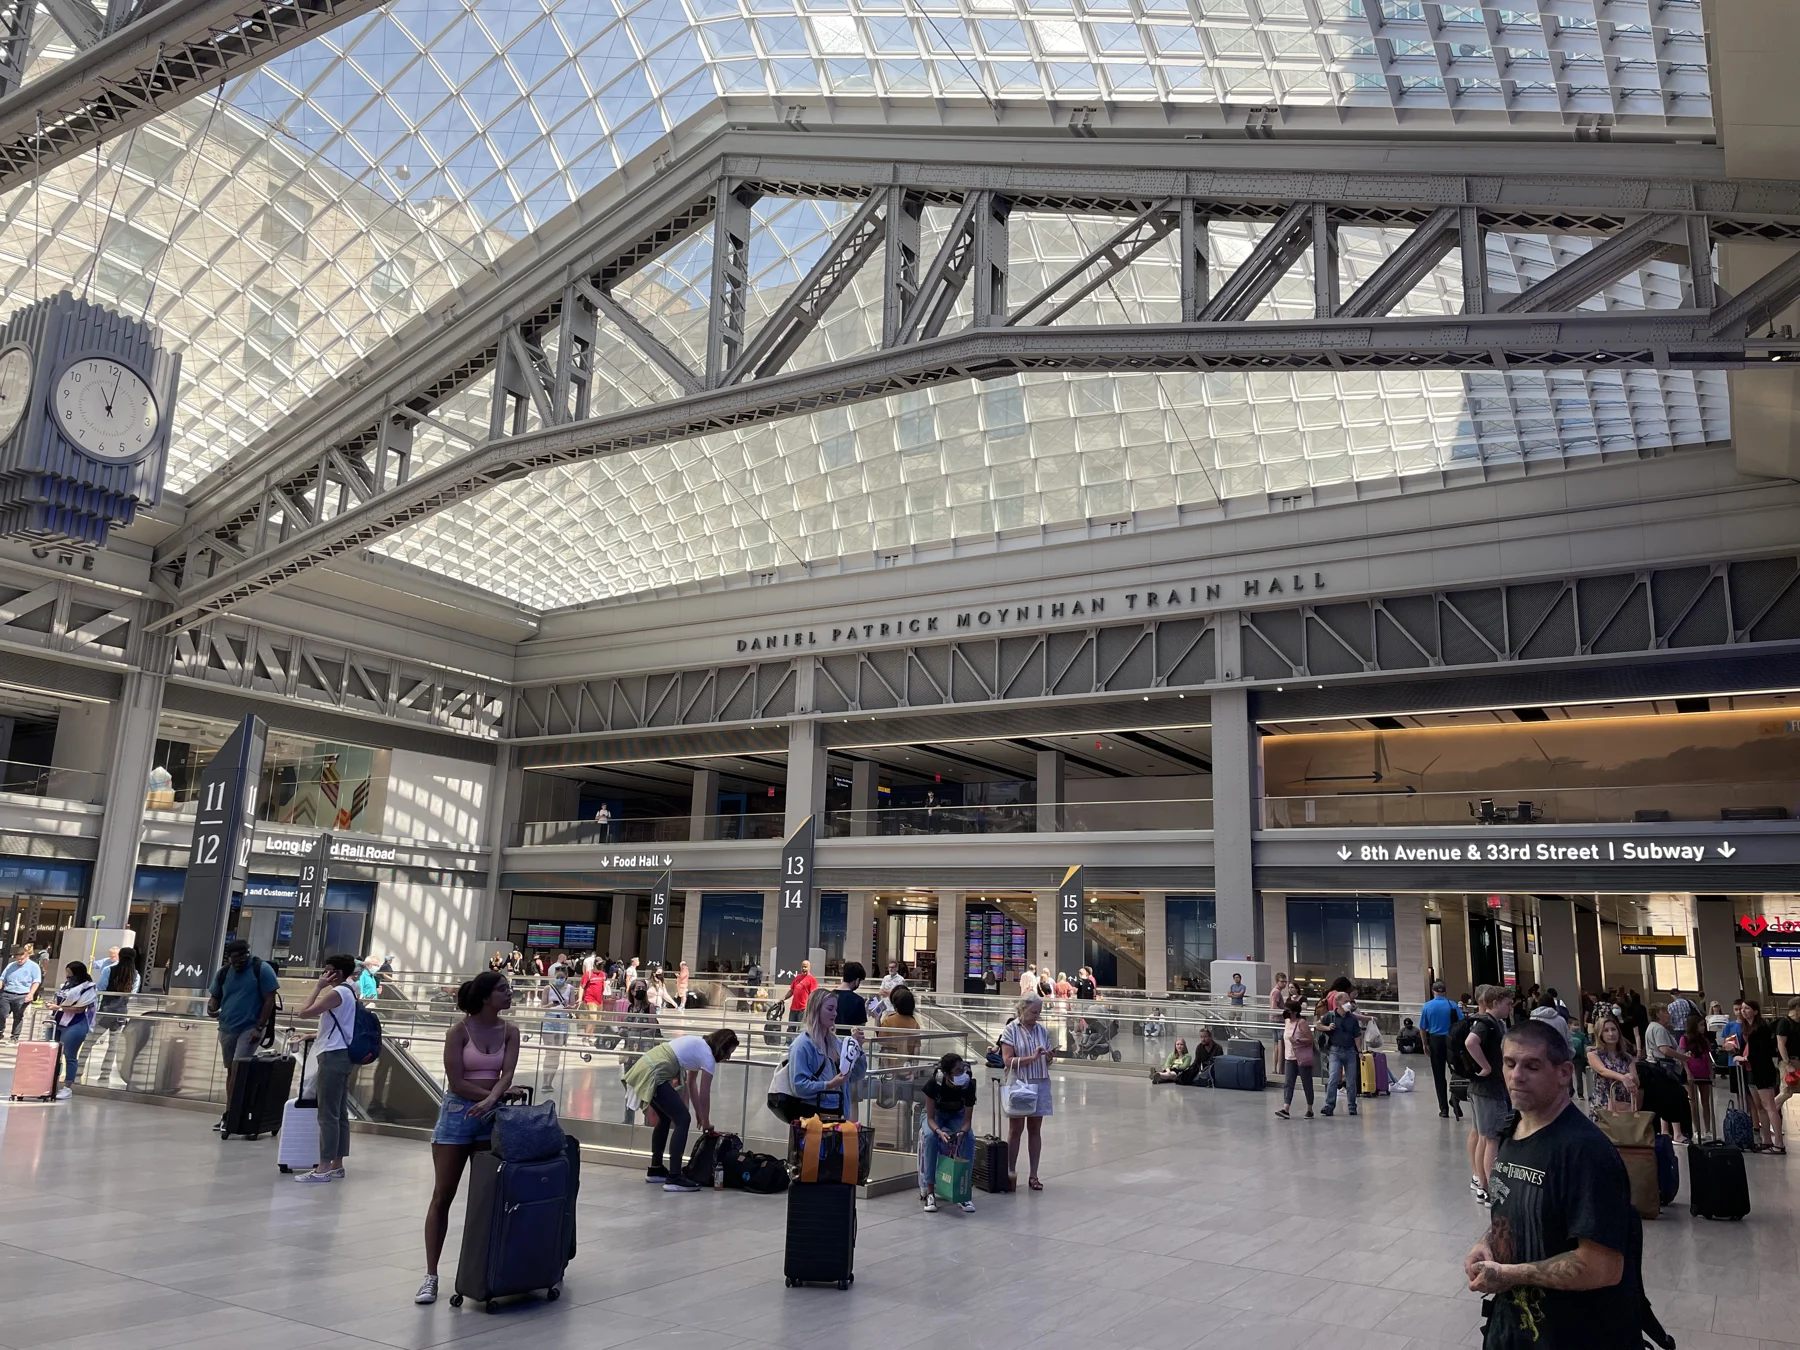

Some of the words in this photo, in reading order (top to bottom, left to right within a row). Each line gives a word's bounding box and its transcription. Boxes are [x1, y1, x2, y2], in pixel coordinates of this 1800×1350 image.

[89, 363, 98, 374] 11
[109, 365, 120, 377] 12
[71, 371, 82, 383] 10
[132, 379, 136, 388] 1
[63, 389, 70, 399] 9
[142, 397, 149, 407] 2
[65, 410, 73, 420] 8
[144, 418, 151, 427] 3
[79, 429, 86, 439] 7
[136, 434, 142, 443] 4
[98, 442, 105, 451] 6
[119, 443, 126, 452] 5
[736, 631, 816, 651] DANIEL
[831, 616, 939, 642] PATRICK
[956, 597, 1105, 628] MOYNIHAN
[1125, 584, 1220, 609] TRAIN
[1243, 572, 1325, 596] HALL
[204, 781, 226, 811] 11
[246, 785, 257, 816] 11
[195, 834, 220, 865] 12
[238, 837, 251, 868] 12
[266, 836, 299, 855] Long
[341, 844, 364, 858] Rail
[365, 847, 396, 861] Road
[1360, 845, 1390, 861] 8th
[1394, 845, 1462, 861] Avenue
[1467, 844, 1482, 861] &
[1486, 844, 1531, 860] 33rd
[1536, 844, 1600, 860] Street
[1622, 842, 1705, 862] Subway
[613, 854, 637, 868] Food
[639, 854, 659, 867] Hall
[787, 856, 804, 875] 13
[302, 865, 315, 881] 13
[249, 888, 263, 896] and
[263, 888, 295, 897] Customer
[654, 893, 665, 905] 15
[784, 889, 803, 909] 14
[298, 892, 311, 907] 14
[1063, 894, 1078, 908] 15
[653, 913, 664, 925] 16
[1063, 918, 1078, 932] 16
[1508, 1162, 1545, 1185] THRONES
